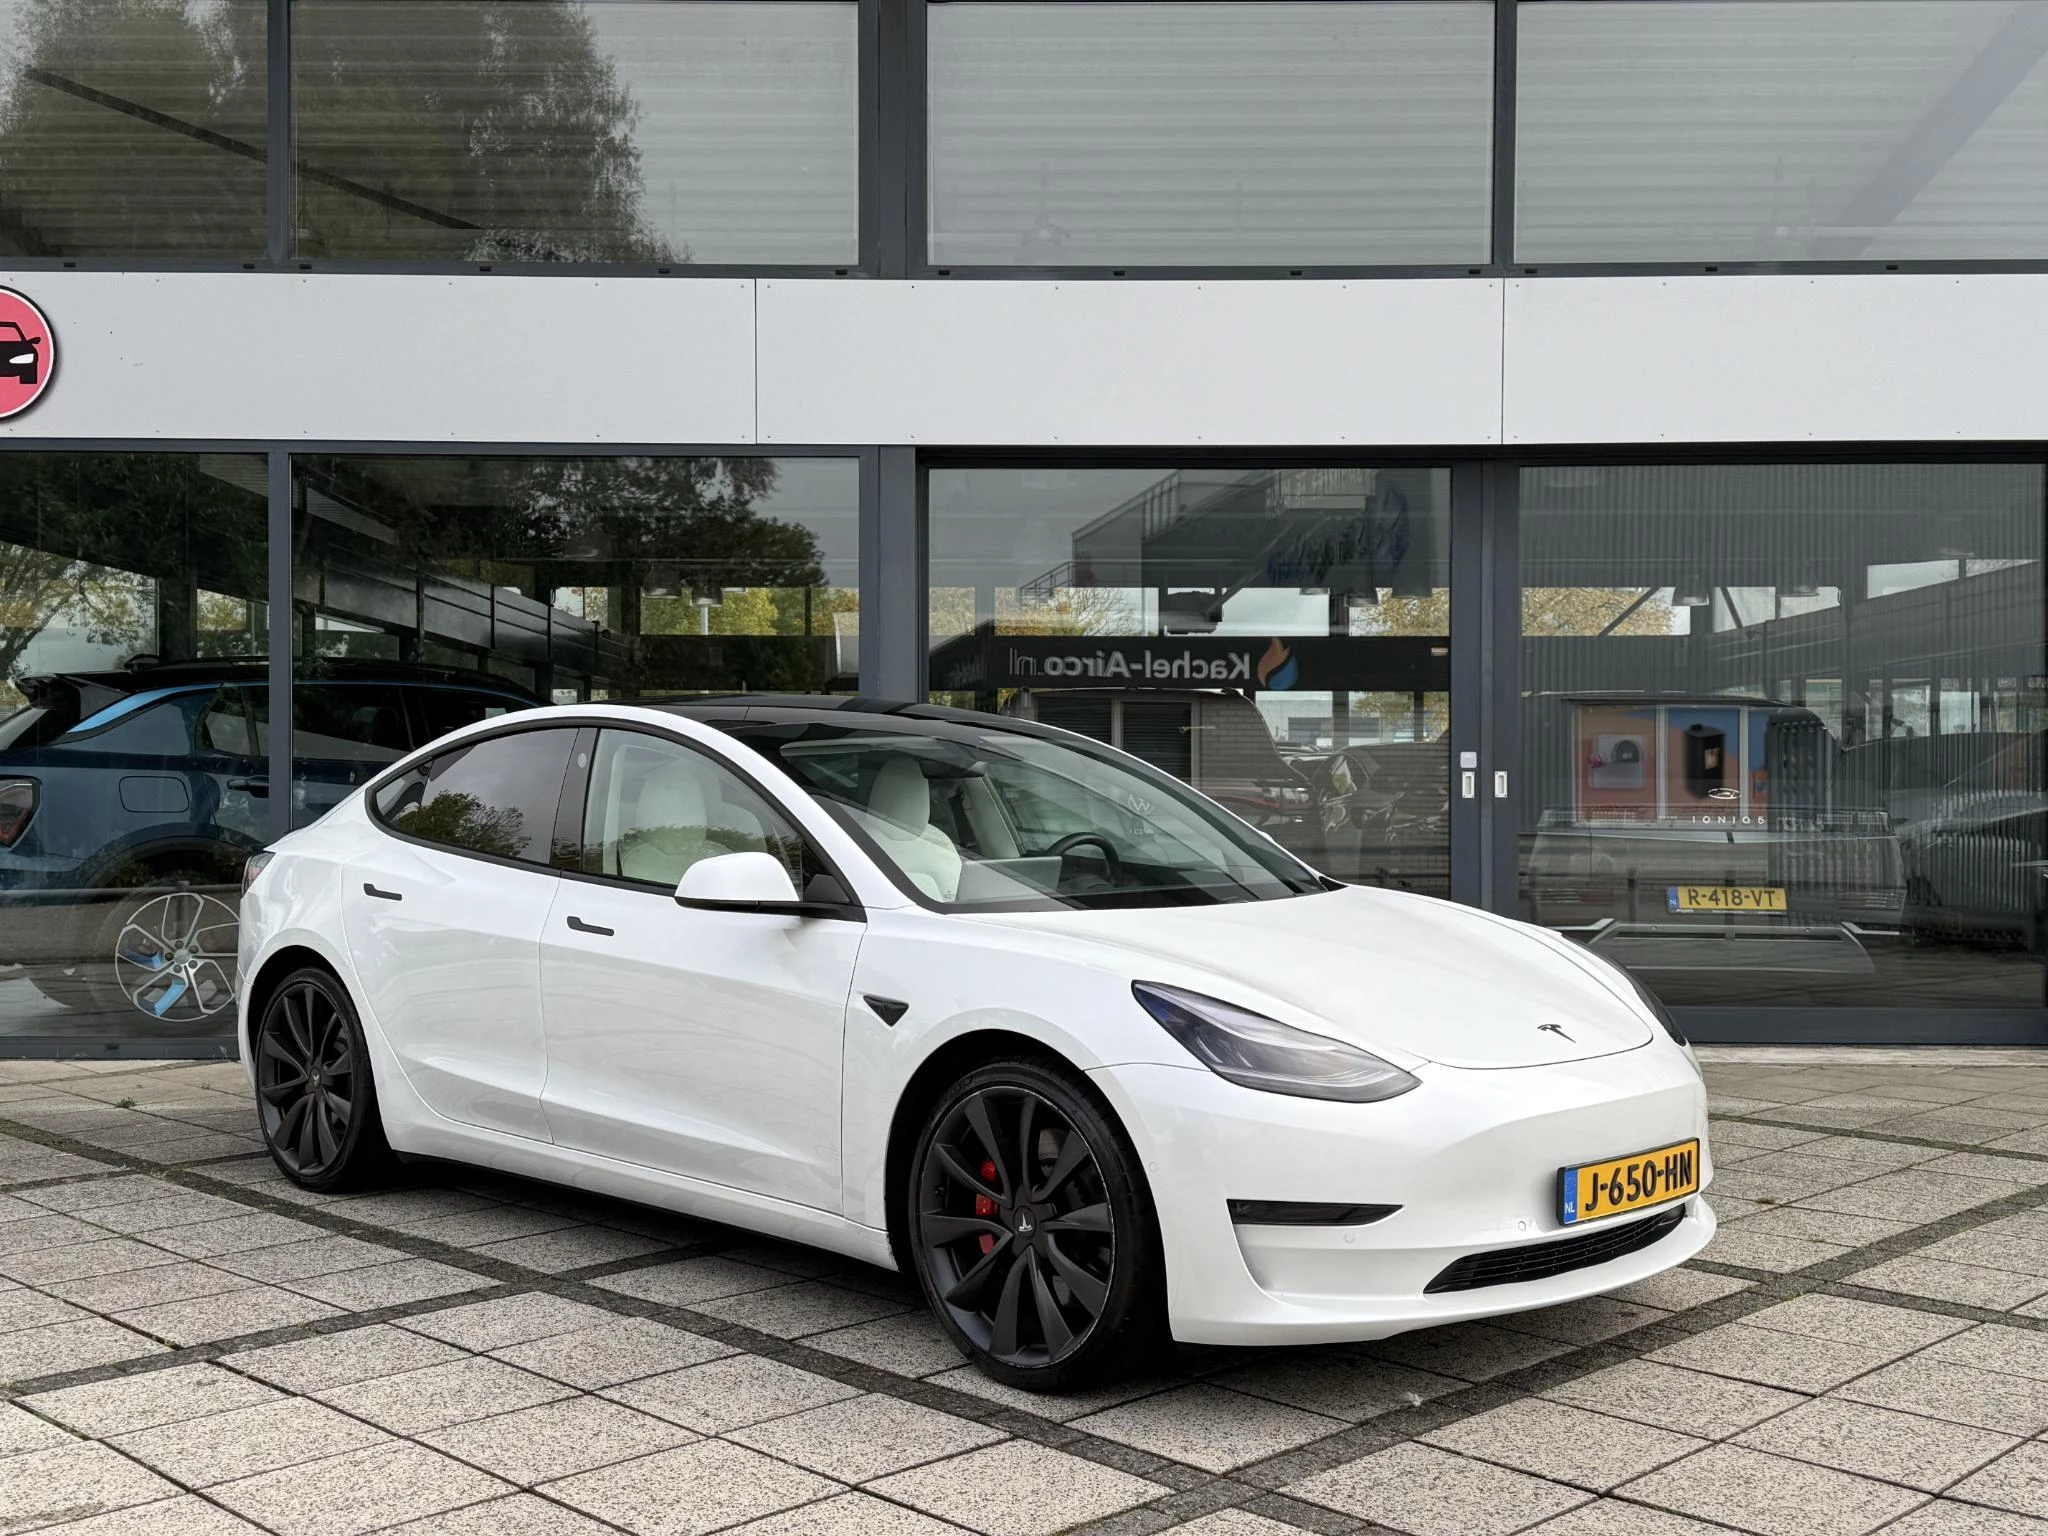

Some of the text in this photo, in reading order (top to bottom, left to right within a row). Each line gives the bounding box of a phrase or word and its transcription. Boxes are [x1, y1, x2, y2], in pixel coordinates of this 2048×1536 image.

[1688, 888, 1775, 907] R-418-VT
[1564, 1149, 1693, 1214] NL J-650-HN
